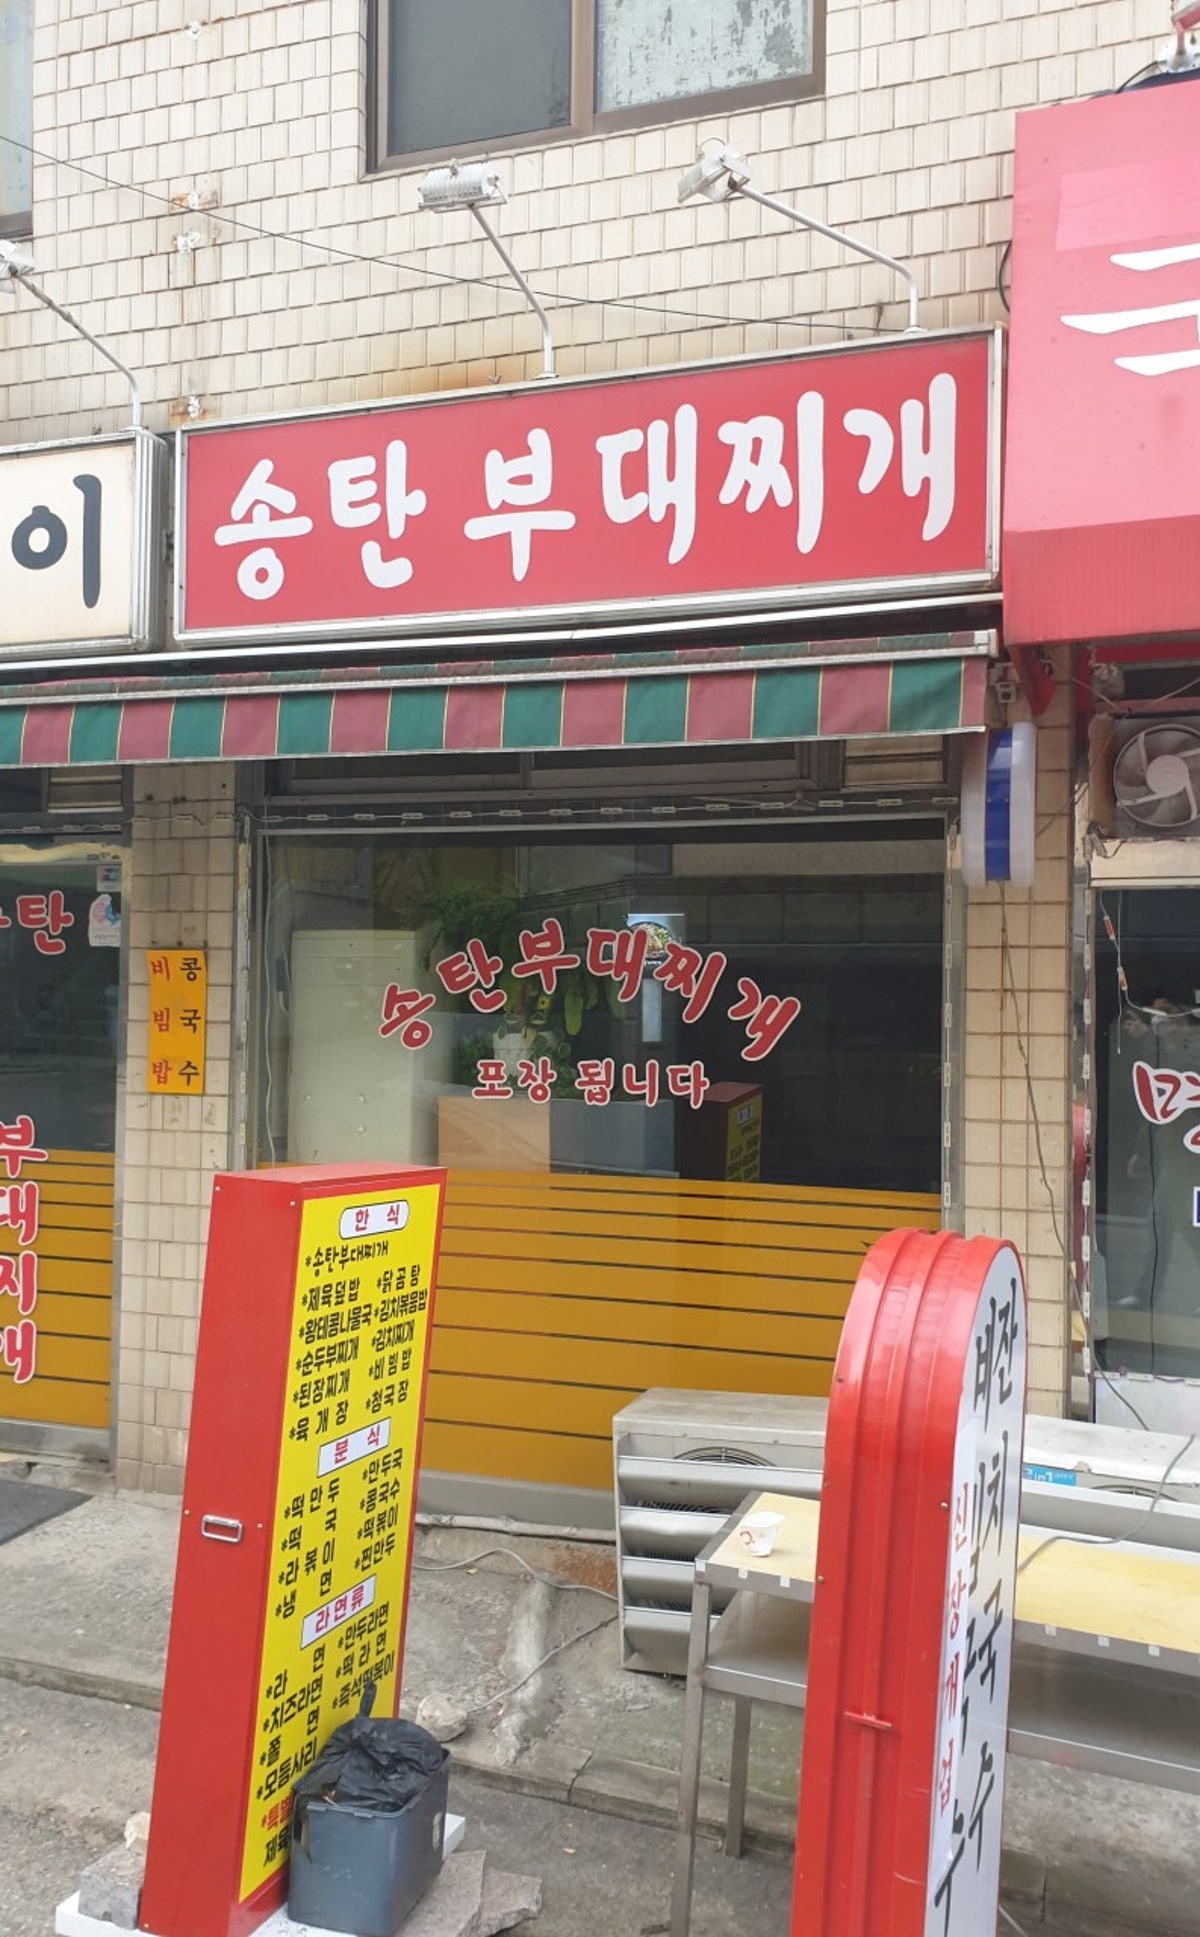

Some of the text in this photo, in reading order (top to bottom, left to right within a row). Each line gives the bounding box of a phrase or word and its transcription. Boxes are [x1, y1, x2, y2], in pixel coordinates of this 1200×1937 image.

[214, 373, 957, 601] 송탄 부대찌개
[0, 890, 75, 955] 탄
[150, 955, 172, 1086] 비빔밥
[178, 957, 202, 1087] 콩국수
[472, 1056, 710, 1109] 포장 됩니다
[307, 1277, 360, 1312] 제육덮밥
[382, 1264, 420, 1293] 닭곰탕
[305, 1303, 372, 1344] 황태콩나물국
[380, 1288, 428, 1322] 김치볶음밥
[302, 1336, 359, 1376] 순두부찌개
[375, 1319, 415, 1352] 김치찌개
[374, 1348, 412, 1380] 비빔밥
[299, 1368, 350, 1409] 된장찌개
[371, 1378, 409, 1414] 청국장
[296, 1400, 349, 1441] 육개장
[368, 1448, 403, 1484] 만두국
[292, 1477, 340, 1518] 떡만두
[366, 1477, 400, 1514] 콩국수
[364, 1503, 399, 1539] 떡볶이
[285, 1538, 335, 1586] 라볶이
[361, 1532, 396, 1572] 찐만두
[968, 1277, 1017, 1874] 잔치국수
[315, 1585, 364, 1634] 라면류
[345, 1600, 390, 1651] 만두라면
[343, 1629, 387, 1676] 떡라면
[938, 1481, 968, 1817] 신장개업
[269, 1674, 323, 1734] 치즈라면
[263, 1736, 317, 1801] 모듬사리
